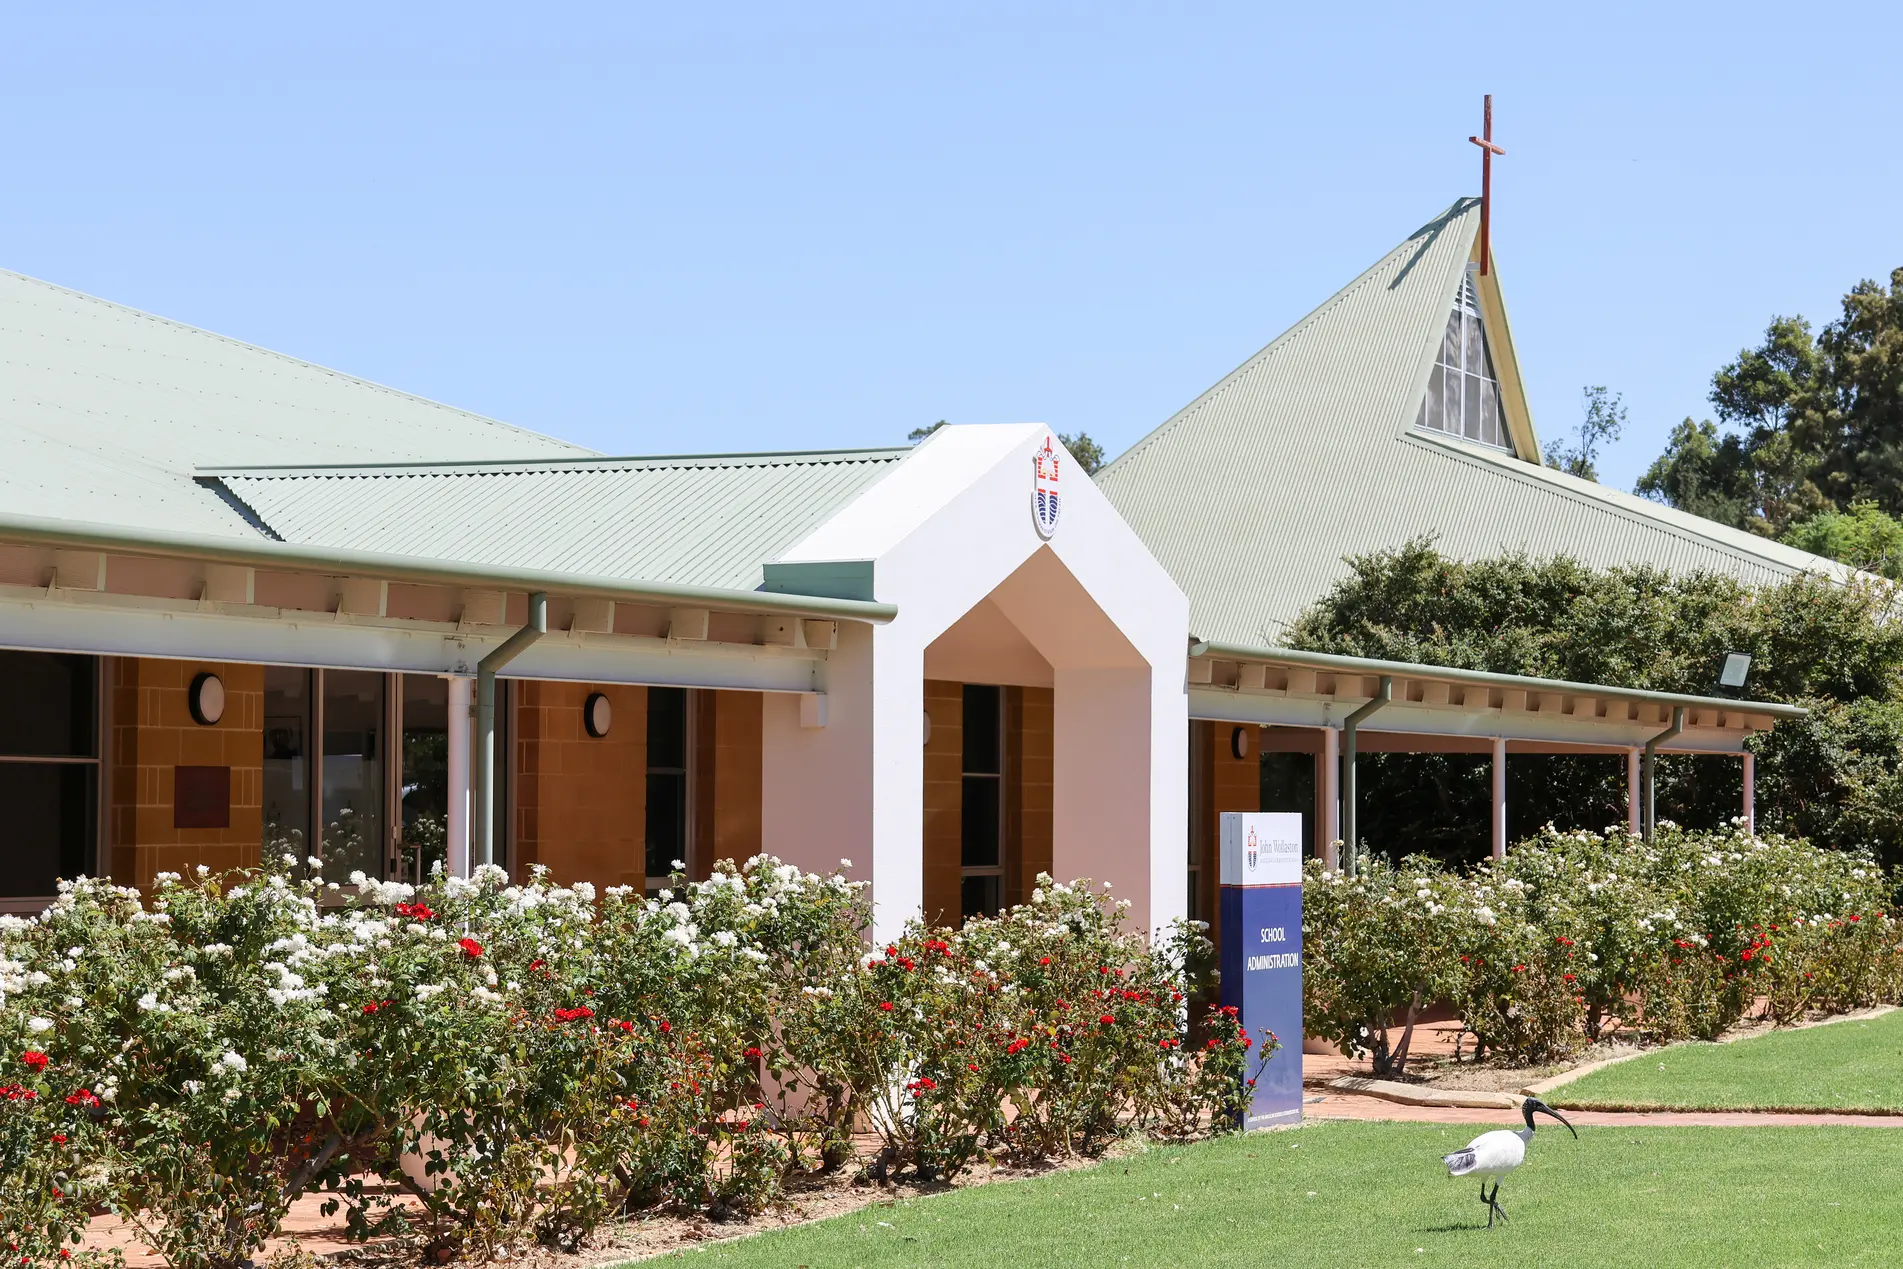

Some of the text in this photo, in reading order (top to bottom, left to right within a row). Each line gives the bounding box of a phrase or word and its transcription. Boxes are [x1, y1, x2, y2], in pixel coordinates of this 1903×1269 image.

[1259, 840, 1298, 856] John Wollaston
[1261, 927, 1285, 943] SCHOOL
[1247, 952, 1298, 971] ADMINISTRATION
